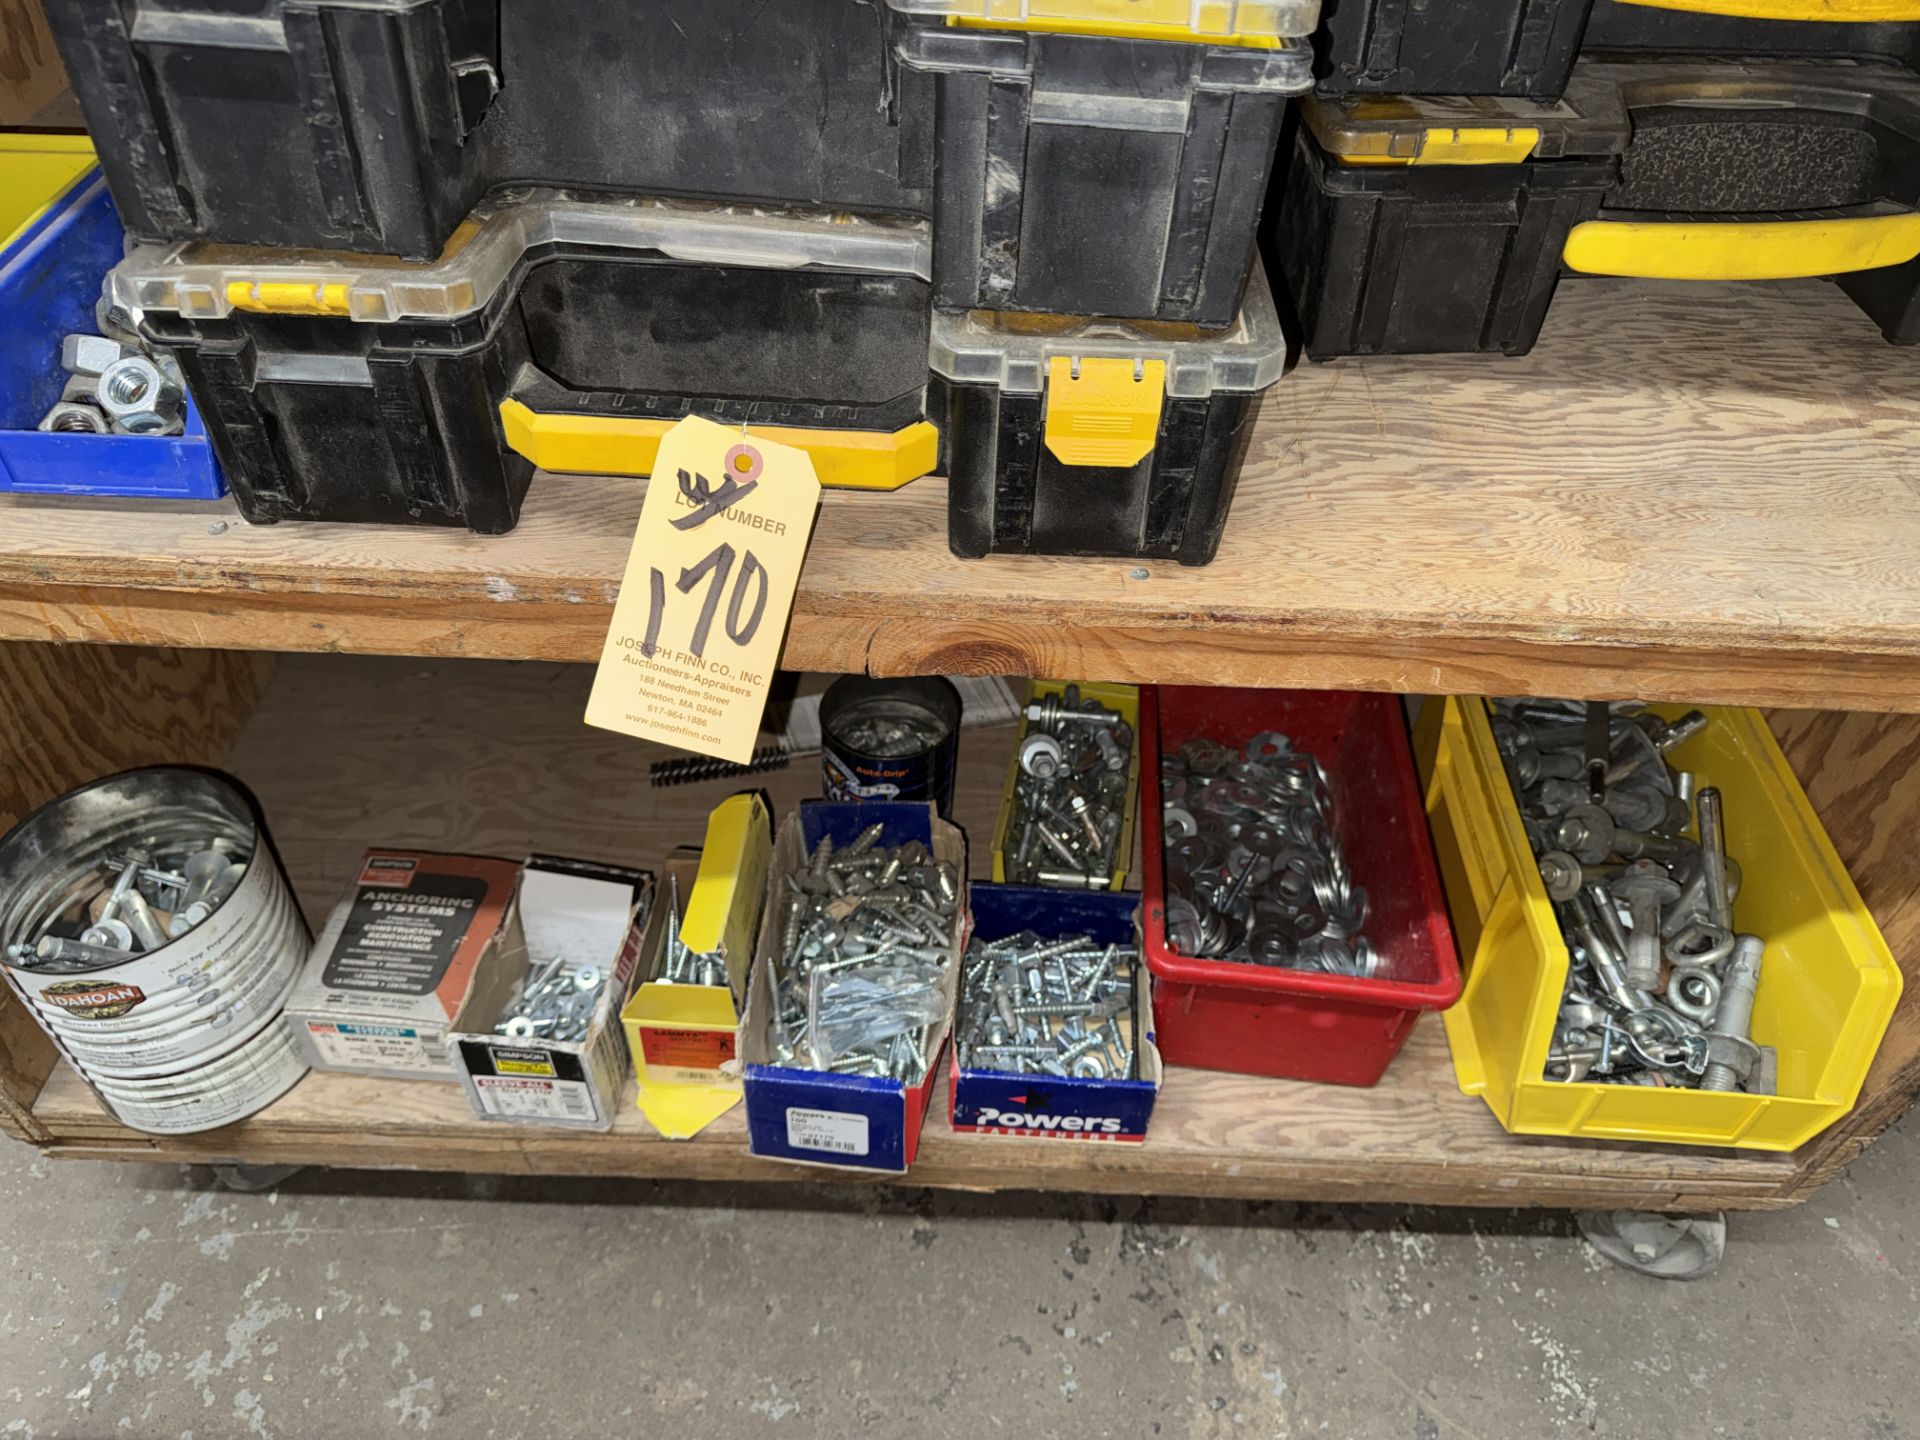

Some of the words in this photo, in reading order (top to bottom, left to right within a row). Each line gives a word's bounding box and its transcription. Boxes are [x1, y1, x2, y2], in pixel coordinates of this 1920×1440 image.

[715, 503, 787, 536] NUMBER
[641, 541, 768, 660] 170
[616, 636, 673, 660] JOSEPH
[675, 652, 707, 670] FINN
[710, 662, 736, 680] CO.,
[739, 670, 765, 687] INC.
[622, 653, 752, 698] Auctioneers-Appraisers
[638, 687, 676, 705] Newton,
[678, 698, 694, 709] MA
[696, 702, 723, 718] 02464
[639, 674, 655, 685] 188
[657, 679, 701, 698] Needham
[703, 691, 730, 706] Street
[625, 712, 721, 745] www.josephfinn.com
[363, 891, 474, 909] ANCHORING
[371, 901, 457, 917] SYSTEMS
[363, 924, 443, 937] CONSTRUCTION
[367, 931, 432, 943] RENOVATION
[359, 938, 433, 951] MAINTENANCE
[48, 988, 135, 1007] IDAHOAN
[497, 1051, 545, 1060] SIMPSON
[976, 1106, 1121, 1133] Powers
